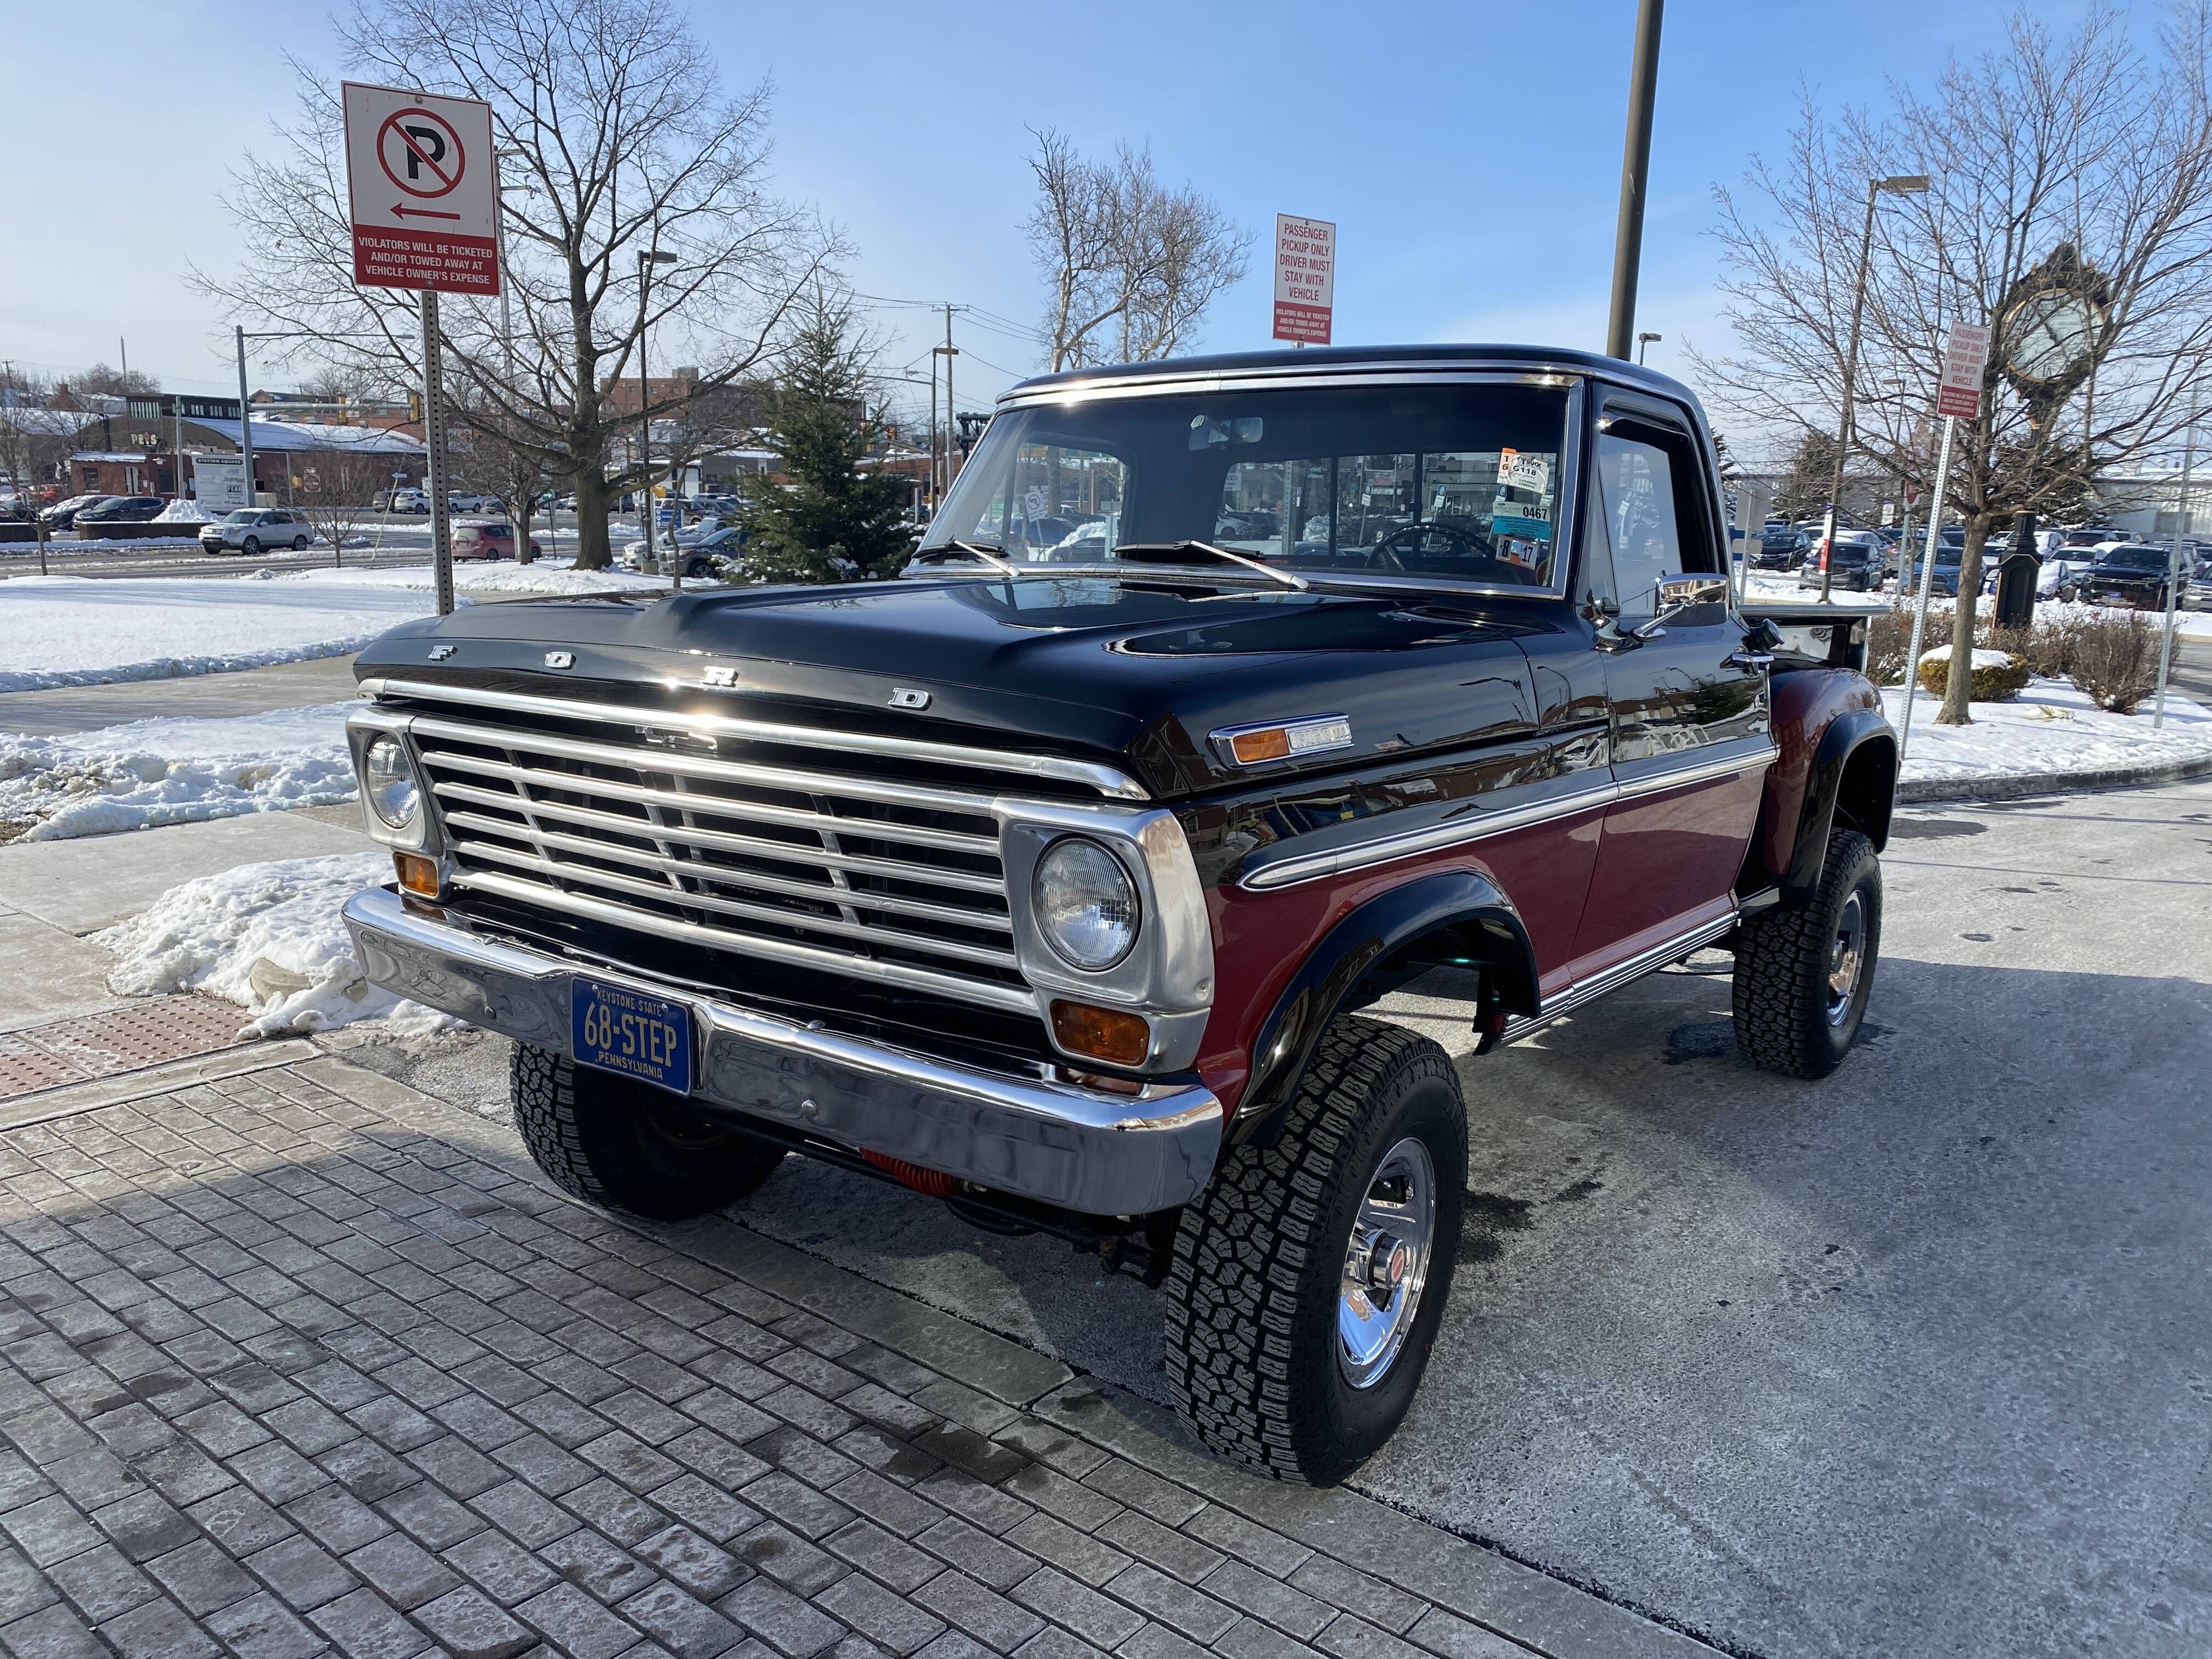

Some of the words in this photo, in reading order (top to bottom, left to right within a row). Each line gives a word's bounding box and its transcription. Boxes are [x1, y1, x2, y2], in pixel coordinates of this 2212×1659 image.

[405, 125, 445, 179] P
[1284, 223, 1328, 241] PASSENGER
[358, 236, 410, 251] VIOLATORS
[412, 242, 435, 253] WILL
[437, 245, 449, 255] BE
[450, 246, 493, 258] TICKETED
[1282, 239, 1309, 253] PICKUP
[1311, 243, 1329, 257] ONLY
[371, 252, 407, 264] AND/OR
[409, 255, 442, 267] TOWED
[444, 258, 469, 269] AWAY
[472, 261, 483, 270] AT
[1280, 254, 1307, 268] DRIVER
[1310, 258, 1330, 272] MUST
[365, 264, 404, 277] VEHICLE
[406, 268, 448, 281] OWNER'S
[450, 272, 489, 284] EXPENSE
[1285, 270, 1304, 283] STAY
[1305, 273, 1324, 286] WITH
[1289, 286, 1319, 301] VEHICLE
[1276, 308, 1296, 317] VIOLATORS
[1312, 313, 1330, 321] TICKETED
[1955, 328, 1984, 341] PASSENGER
[1952, 340, 1971, 350] PICKUP
[1971, 342, 1984, 352] ONLY
[1949, 351, 1968, 362] DRIVER
[1968, 354, 1983, 364] MUST
[1951, 363, 1964, 373] STAY
[1964, 365, 1978, 375] WITH
[1953, 375, 1973, 386] VEHICLE
[1513, 465, 1537, 476] G118
[1520, 458, 1542, 469] TRUCK
[1523, 506, 1548, 520] 0467
[1502, 539, 1510, 557] 8
[1522, 544, 1534, 563] 17
[427, 645, 932, 712] FORD
[597, 988, 635, 1009] KEYSTONE
[639, 999, 662, 1017] STATE
[584, 1001, 677, 1067] 68-STEP
[598, 1050, 663, 1080] PENNSYLVANIA
